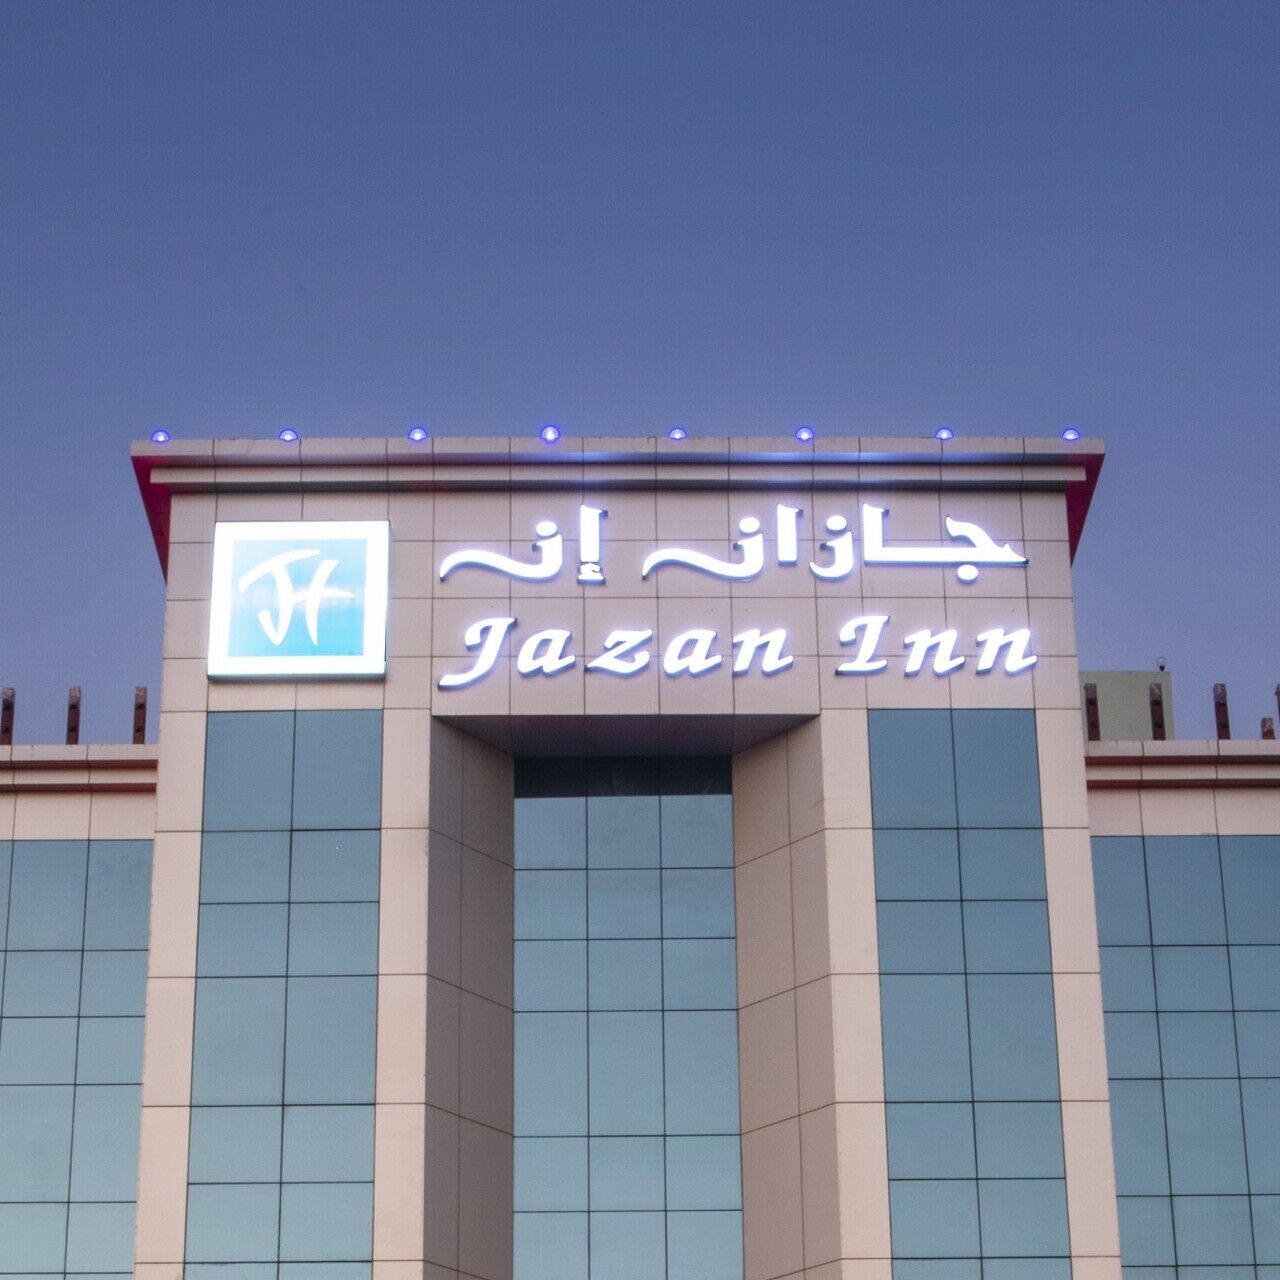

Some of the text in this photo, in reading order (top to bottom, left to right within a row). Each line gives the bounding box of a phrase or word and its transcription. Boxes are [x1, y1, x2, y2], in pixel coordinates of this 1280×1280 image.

[438, 502, 1030, 585] جازان إن
[436, 614, 1038, 692] Jazan Inn
